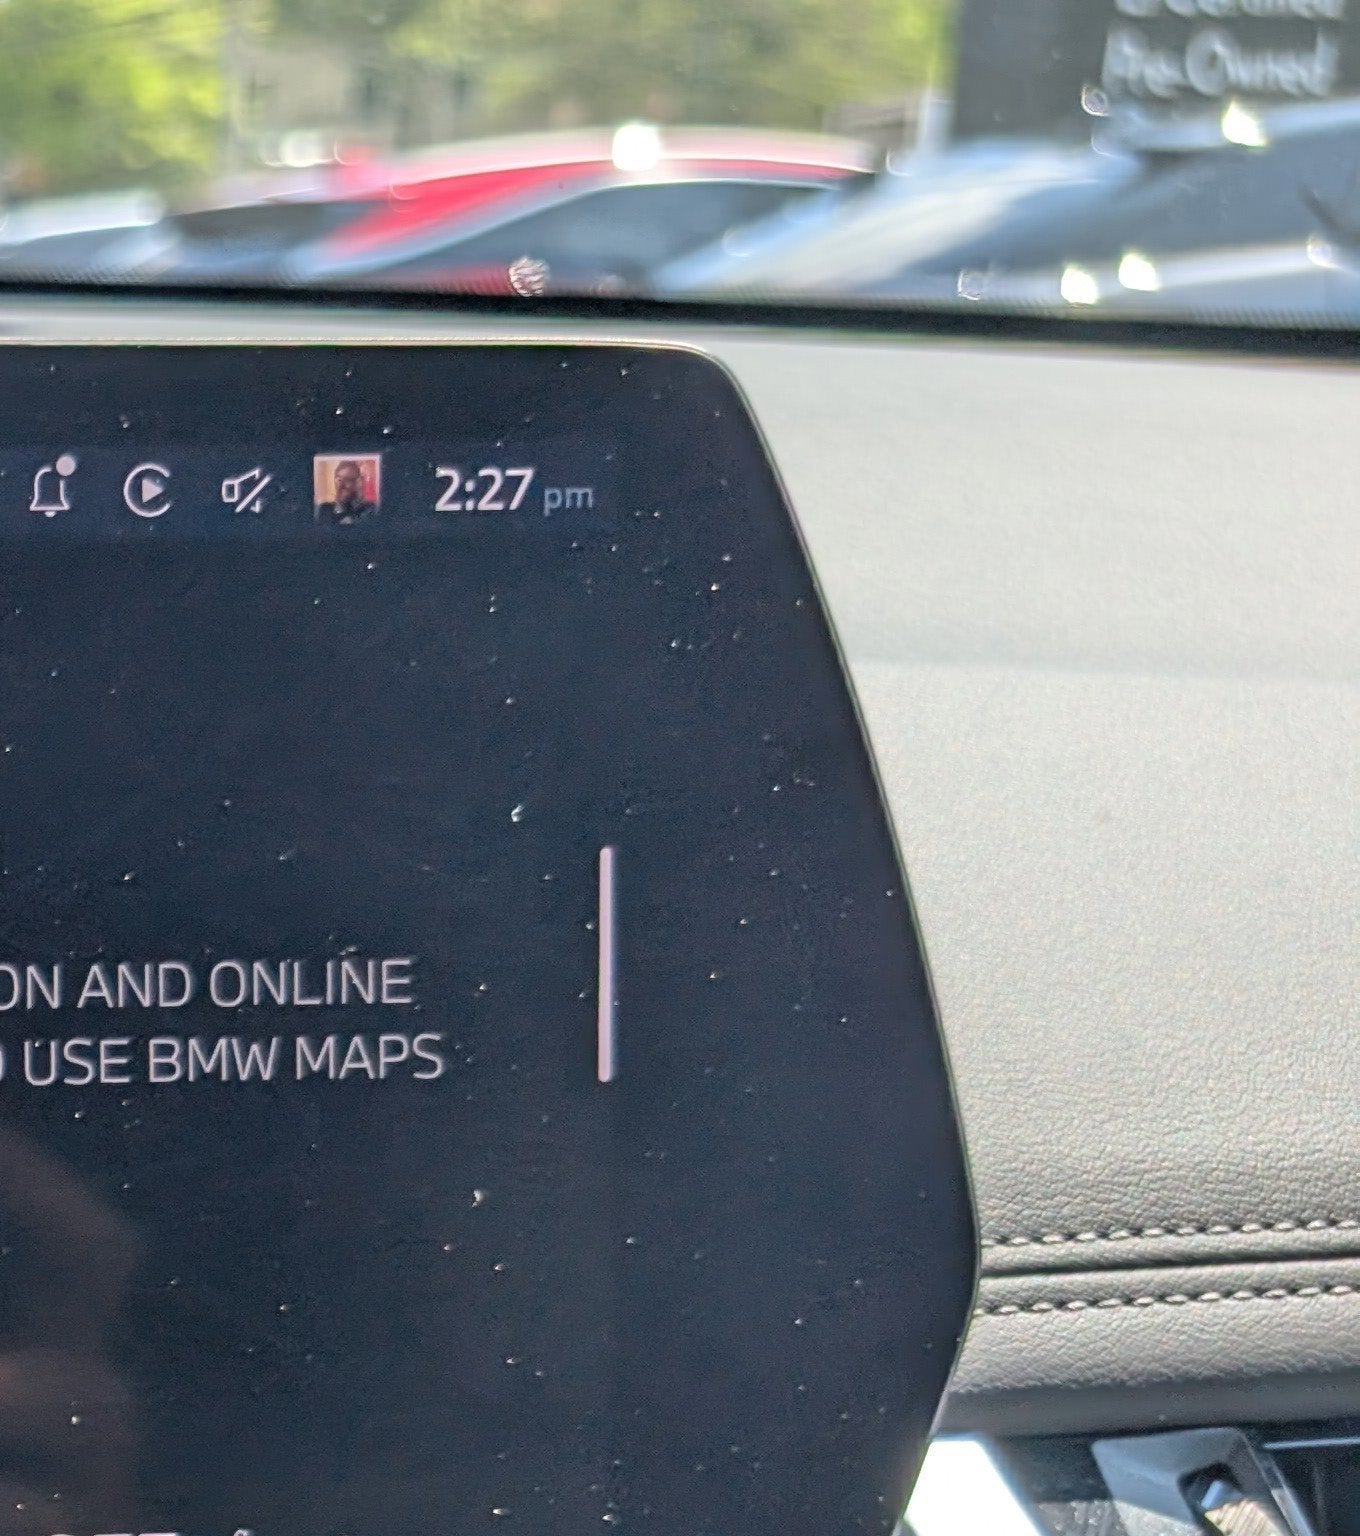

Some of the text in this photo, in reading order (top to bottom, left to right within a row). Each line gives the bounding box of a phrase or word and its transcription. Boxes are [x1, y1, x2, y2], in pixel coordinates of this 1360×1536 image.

[435, 466, 594, 515] 2:27 pm
[76, 961, 193, 1010] AND
[209, 957, 415, 1008] ONLINE
[22, 1037, 131, 1086] USE
[146, 1036, 278, 1084] BMW
[294, 1032, 445, 1081] MAPS
